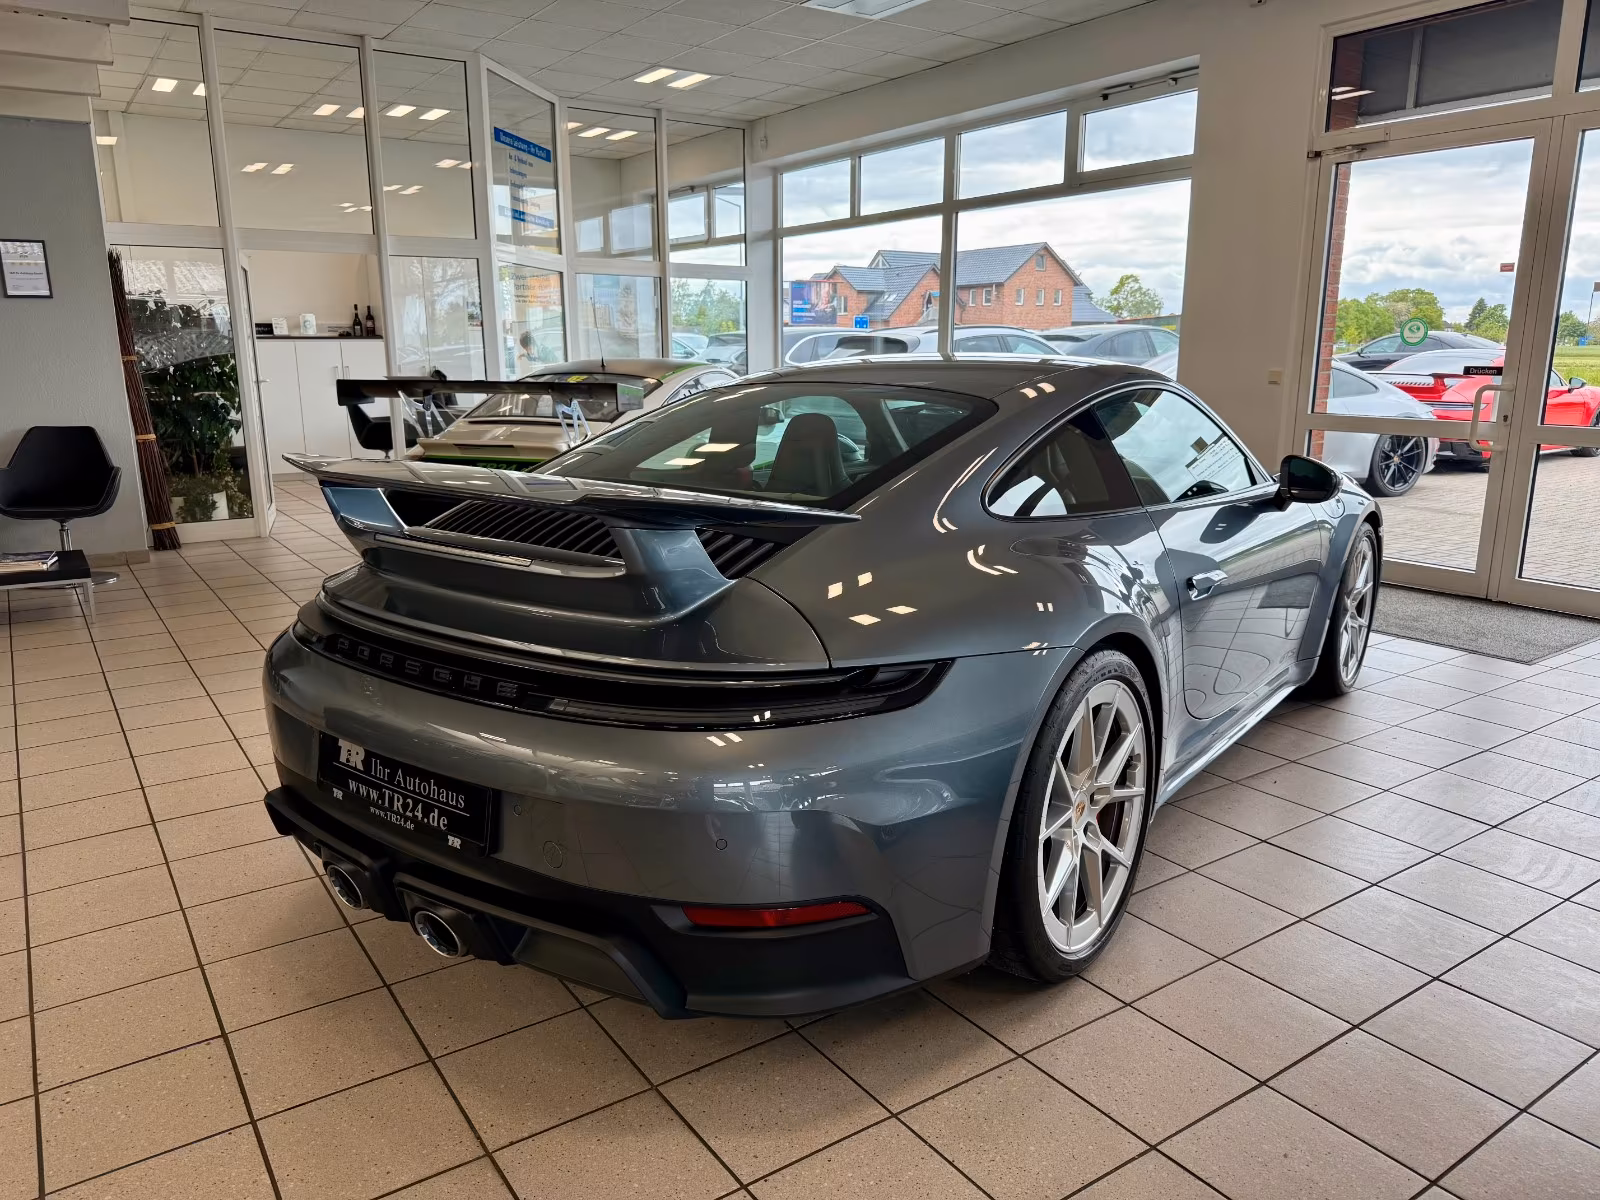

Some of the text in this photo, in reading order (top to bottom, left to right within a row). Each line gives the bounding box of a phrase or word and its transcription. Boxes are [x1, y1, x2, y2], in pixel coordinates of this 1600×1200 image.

[348, 778, 448, 831] www.TR24.de
[370, 757, 391, 781] Ihr
[394, 768, 465, 809] Autohaus
[369, 806, 415, 831] www.TR24.de
